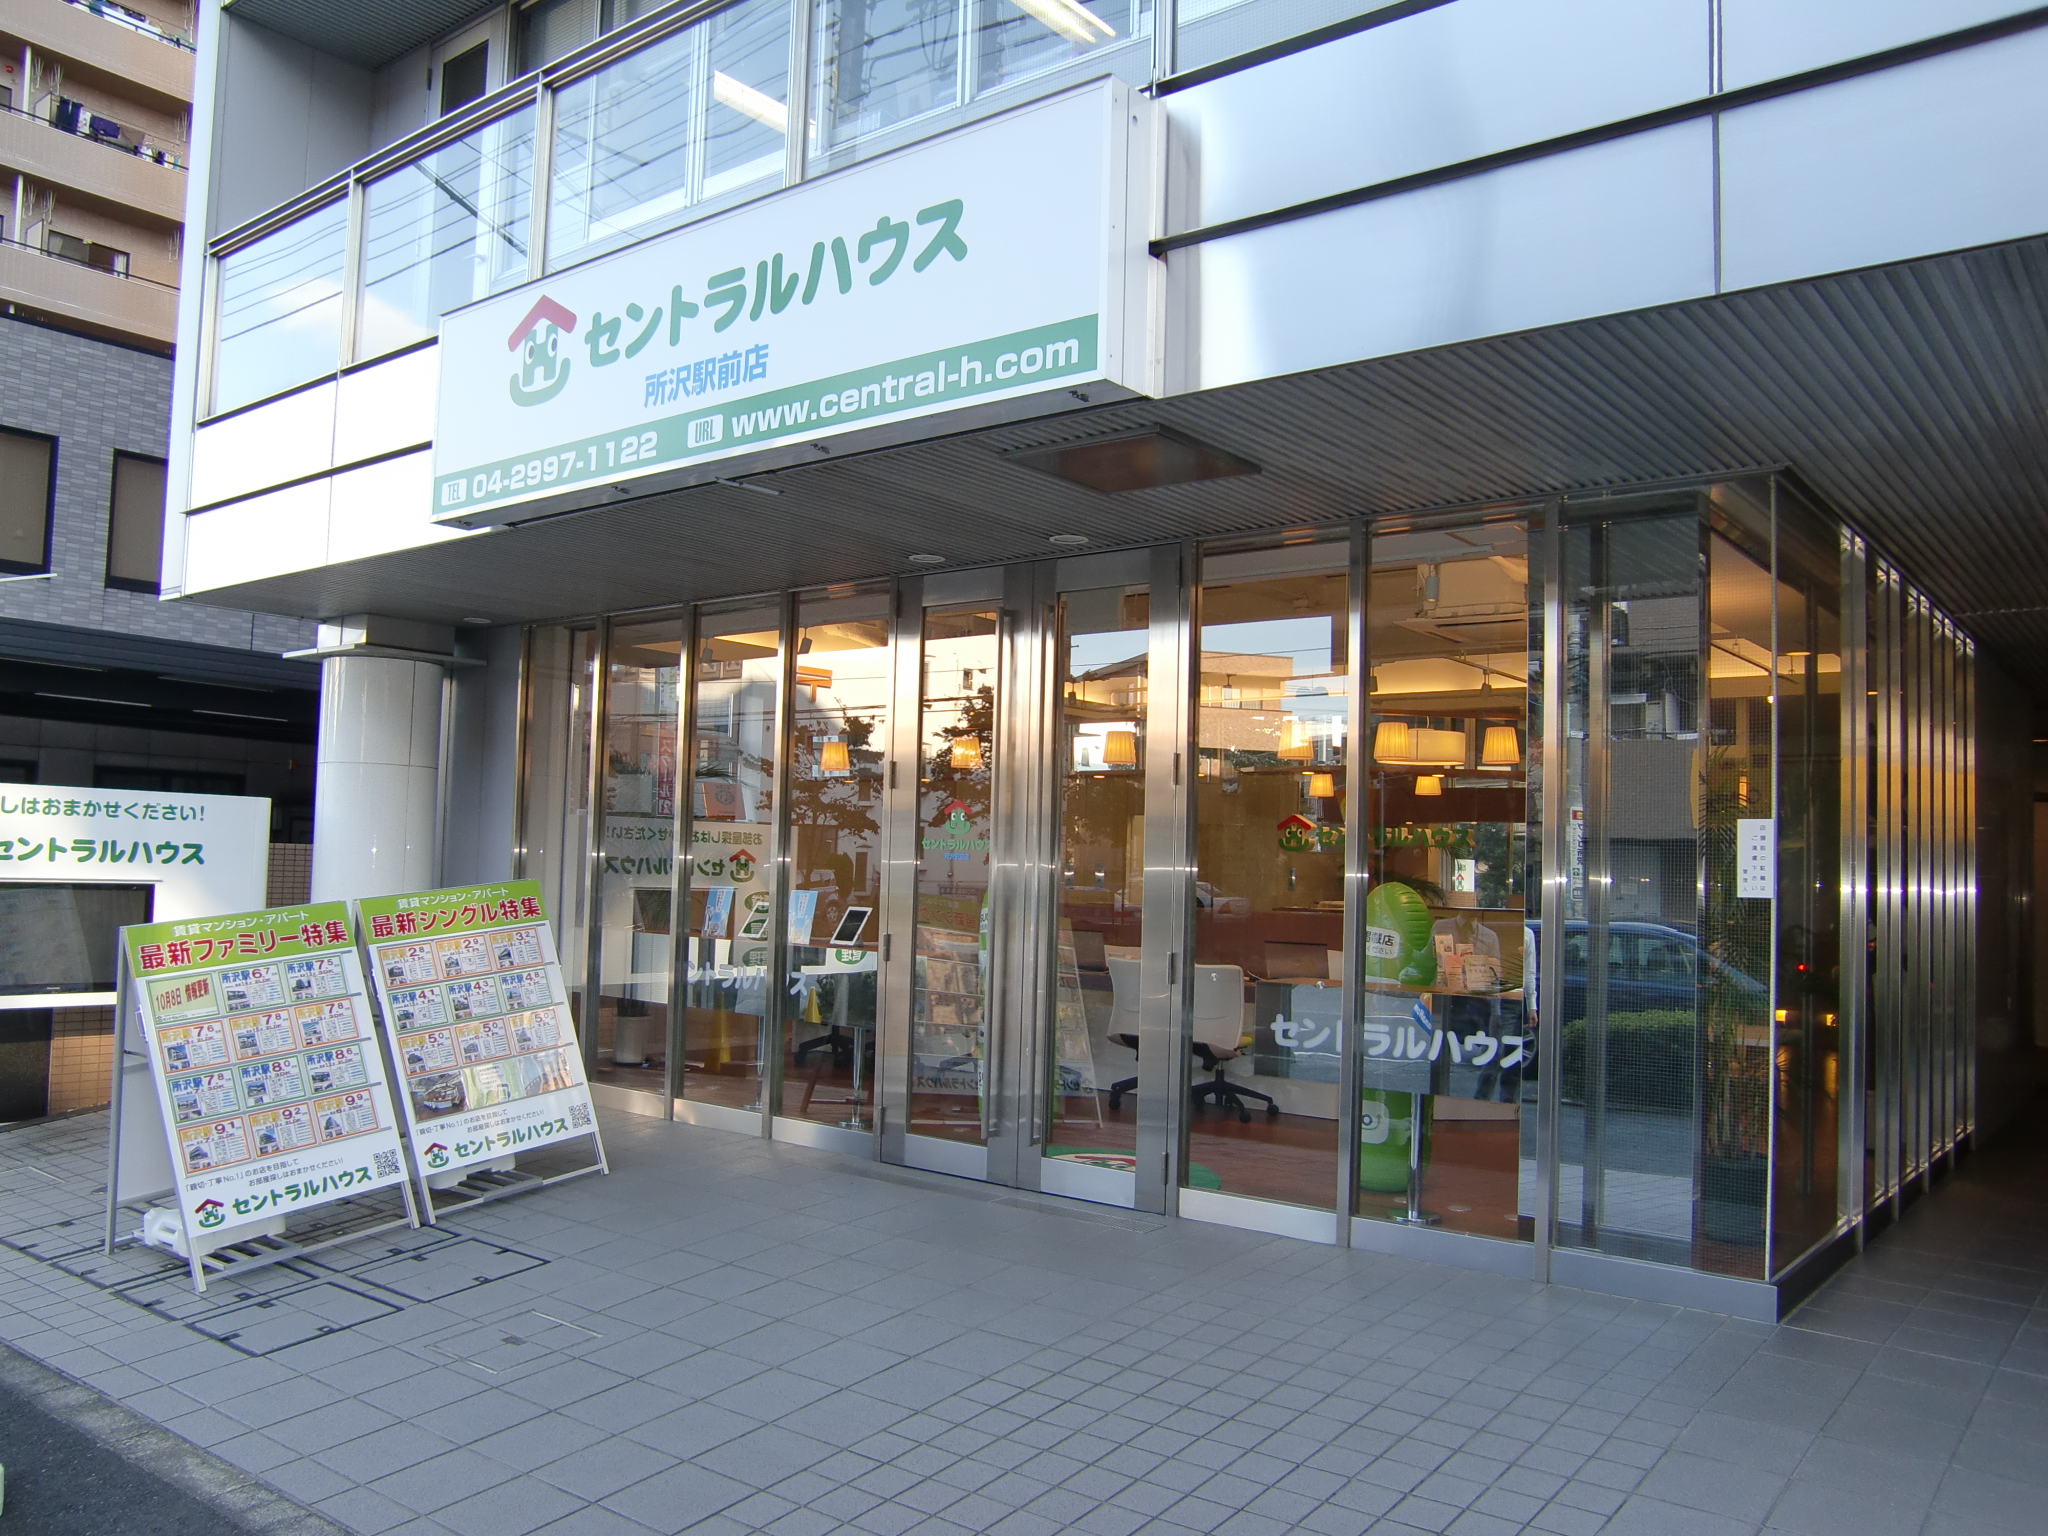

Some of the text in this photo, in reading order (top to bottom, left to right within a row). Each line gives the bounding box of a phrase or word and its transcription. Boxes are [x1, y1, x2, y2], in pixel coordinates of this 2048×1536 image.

[584, 198, 968, 368] セントラルハウス
[643, 343, 769, 409] 所沢駅前店
[448, 334, 1080, 502] TEL 04-2997-1122 URL www.central-h.com
[371, 896, 542, 938] 最新シングル特集
[139, 919, 349, 971] 最新ファミリー特集
[155, 986, 183, 1012] 10月8日
[240, 1063, 271, 1078] 所沢駅
[306, 1051, 335, 1066] 所沢駅
[171, 1077, 204, 1093] 所沢駅
[454, 1117, 569, 1158] セントラルハウス
[232, 1166, 372, 1216] セントラルハウス
